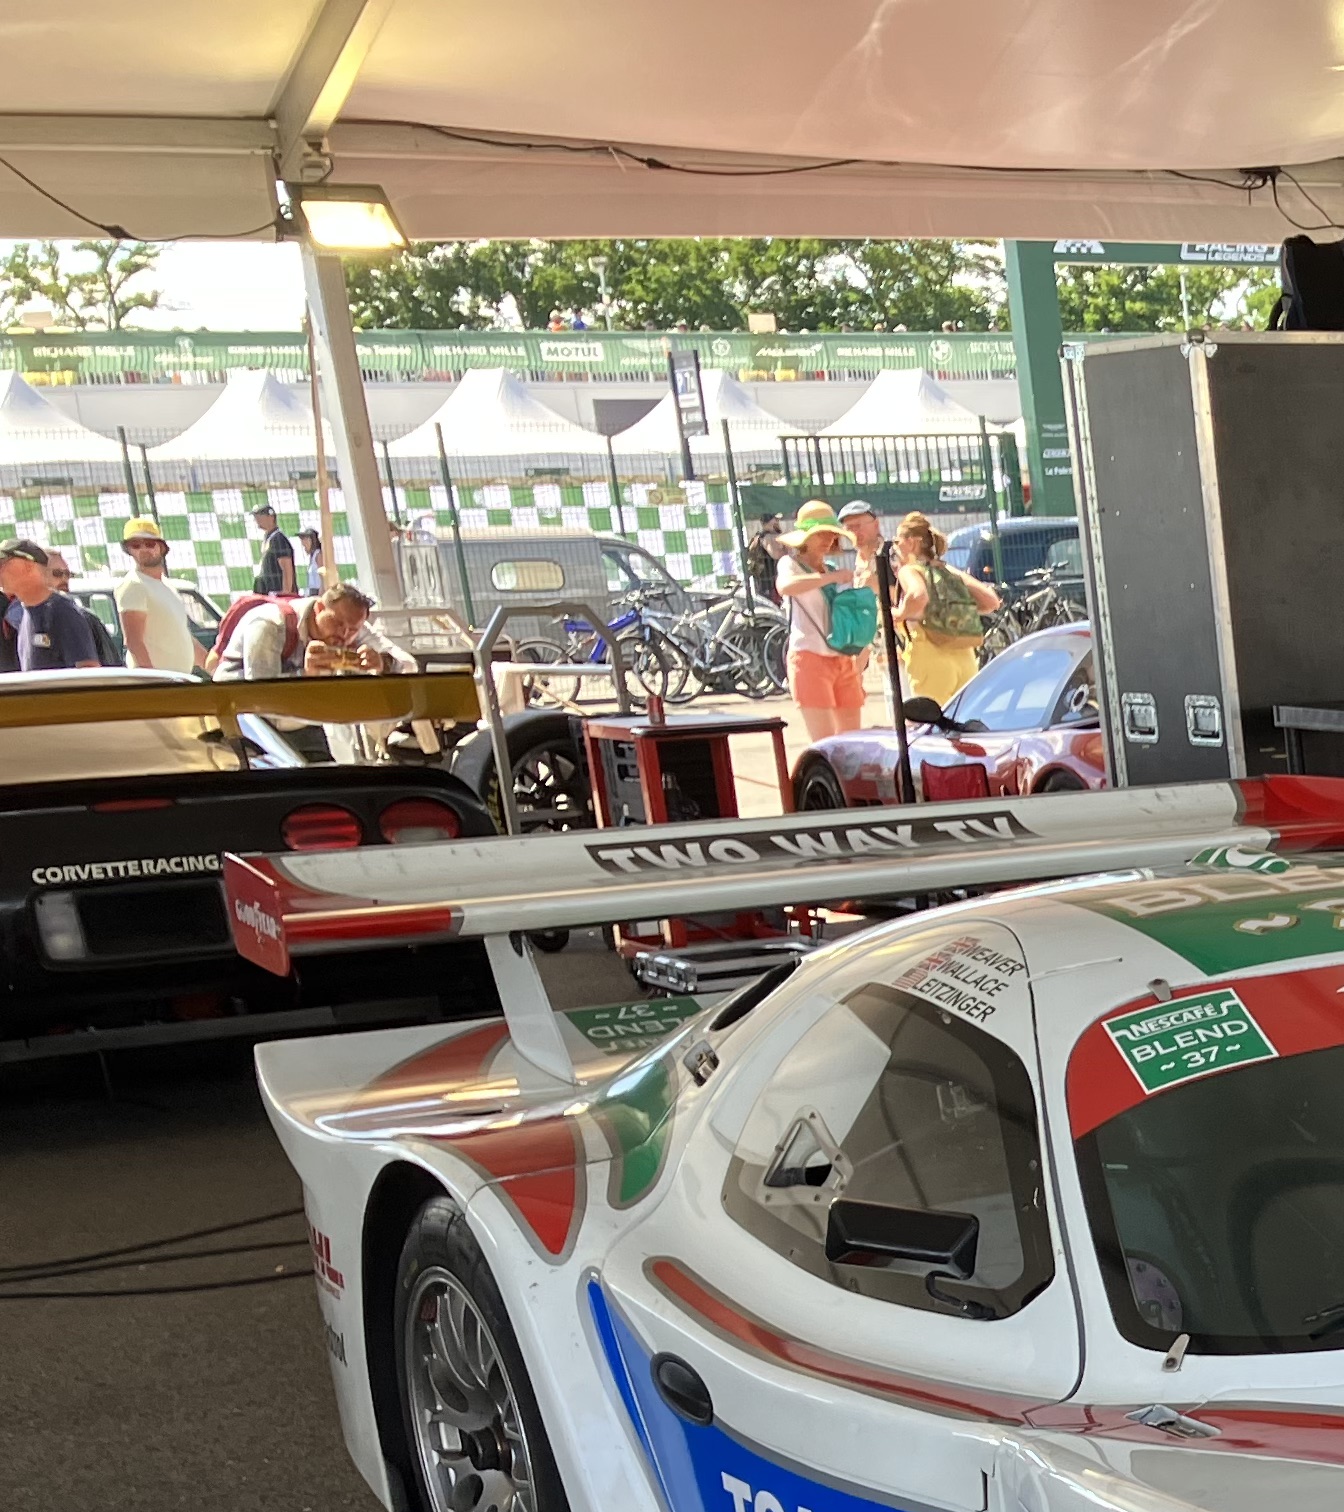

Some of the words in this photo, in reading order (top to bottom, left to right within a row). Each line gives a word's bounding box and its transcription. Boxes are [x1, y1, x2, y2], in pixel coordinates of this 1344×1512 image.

[1208, 252, 1266, 262] LEGENDS
[546, 345, 600, 358] MOTUL
[598, 838, 761, 874] TWO
[771, 824, 918, 861] WAY
[933, 816, 1013, 844] TV
[936, 959, 1009, 997] WALLACE
[961, 945, 1025, 977] WEAVER
[912, 978, 997, 1023] LEITZINGER
[1130, 1020, 1249, 1063] BLEND
